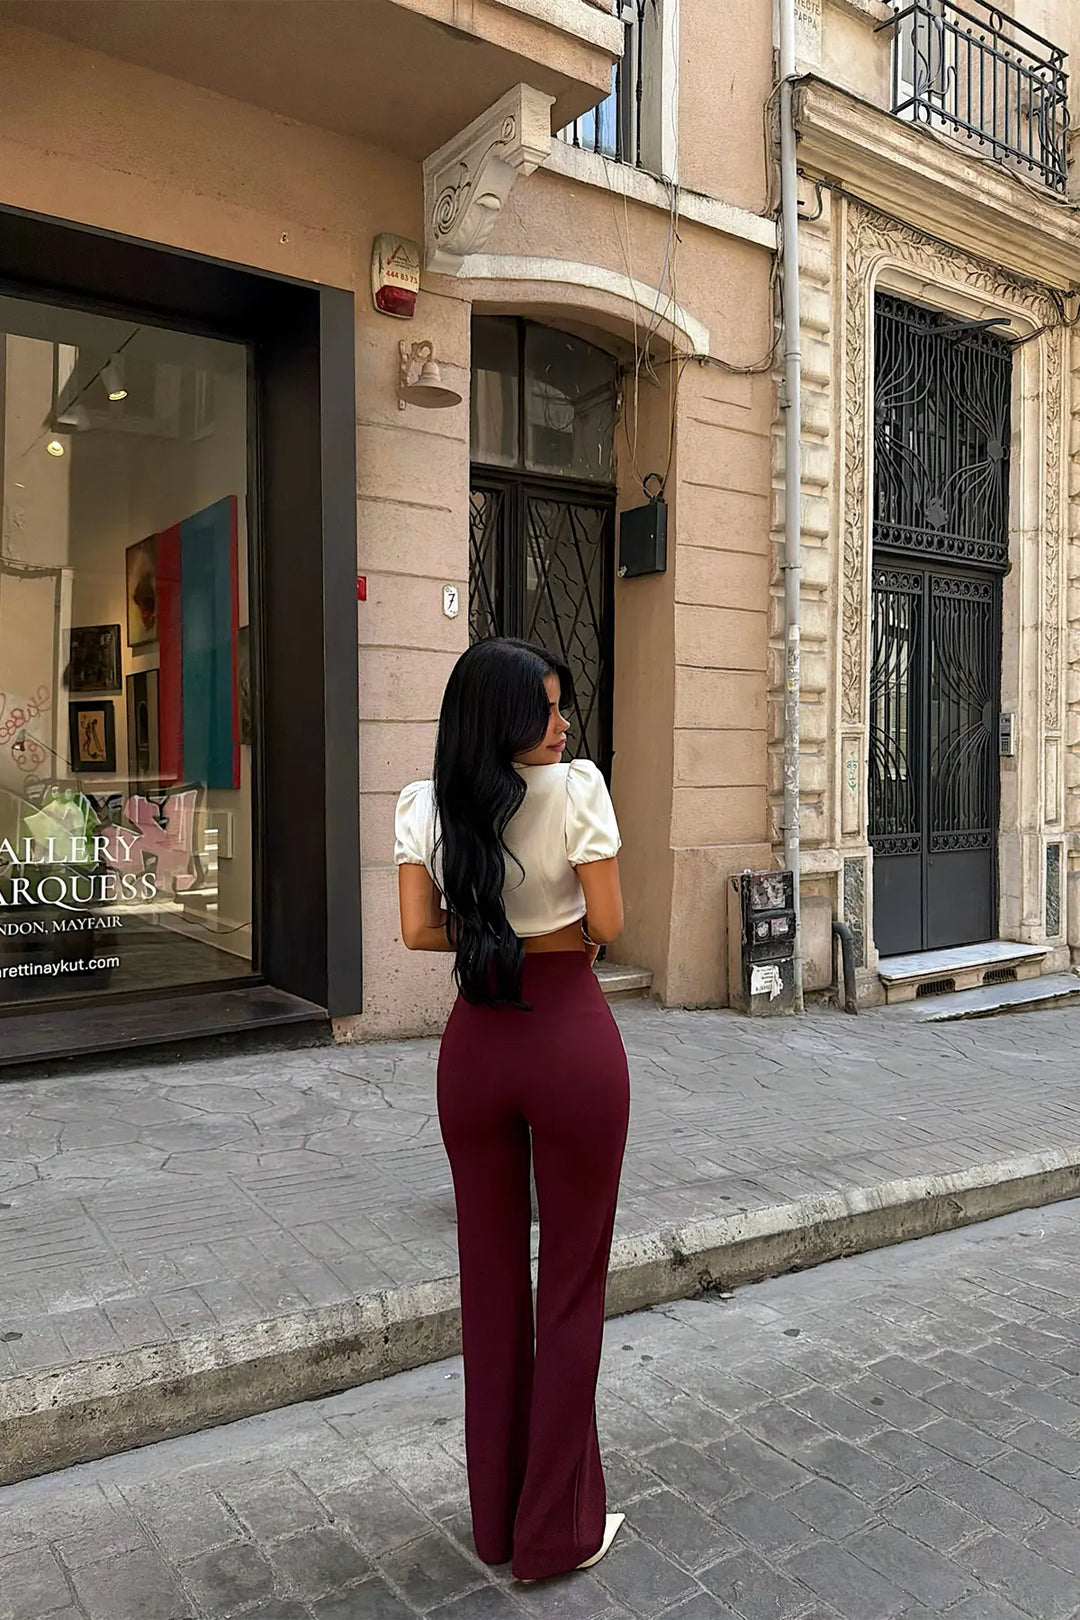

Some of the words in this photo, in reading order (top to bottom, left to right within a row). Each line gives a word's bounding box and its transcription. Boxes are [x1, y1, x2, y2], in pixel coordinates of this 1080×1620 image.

[448, 593, 455, 610] 7
[52, 916, 123, 932] MAYFAIR
[0, 957, 120, 979] rettinaykut.com
